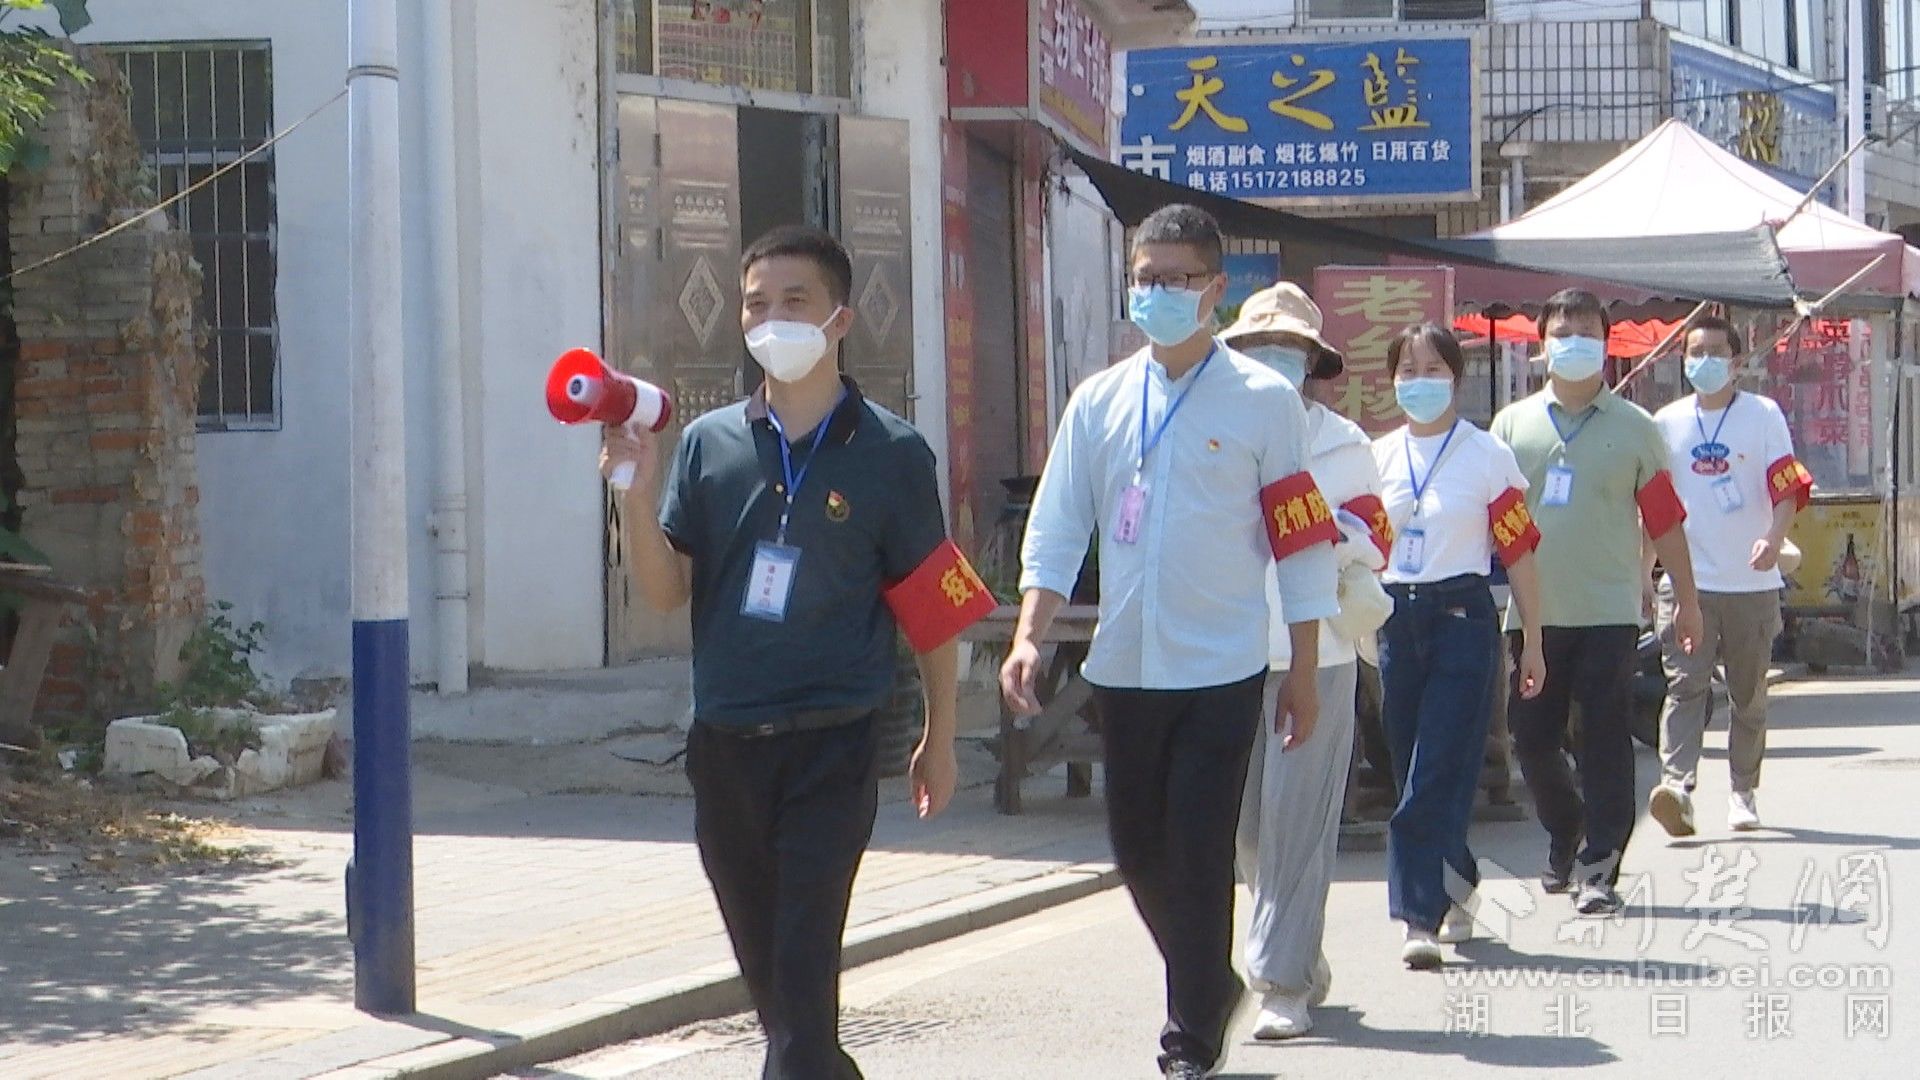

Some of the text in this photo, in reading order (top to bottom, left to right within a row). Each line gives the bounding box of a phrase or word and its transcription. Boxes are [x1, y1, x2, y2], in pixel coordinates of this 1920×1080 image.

[1186, 140, 1450, 166] 烟酒副食 烟花爆竹 日用百货
[1333, 275, 1433, 439] 老乡杨
